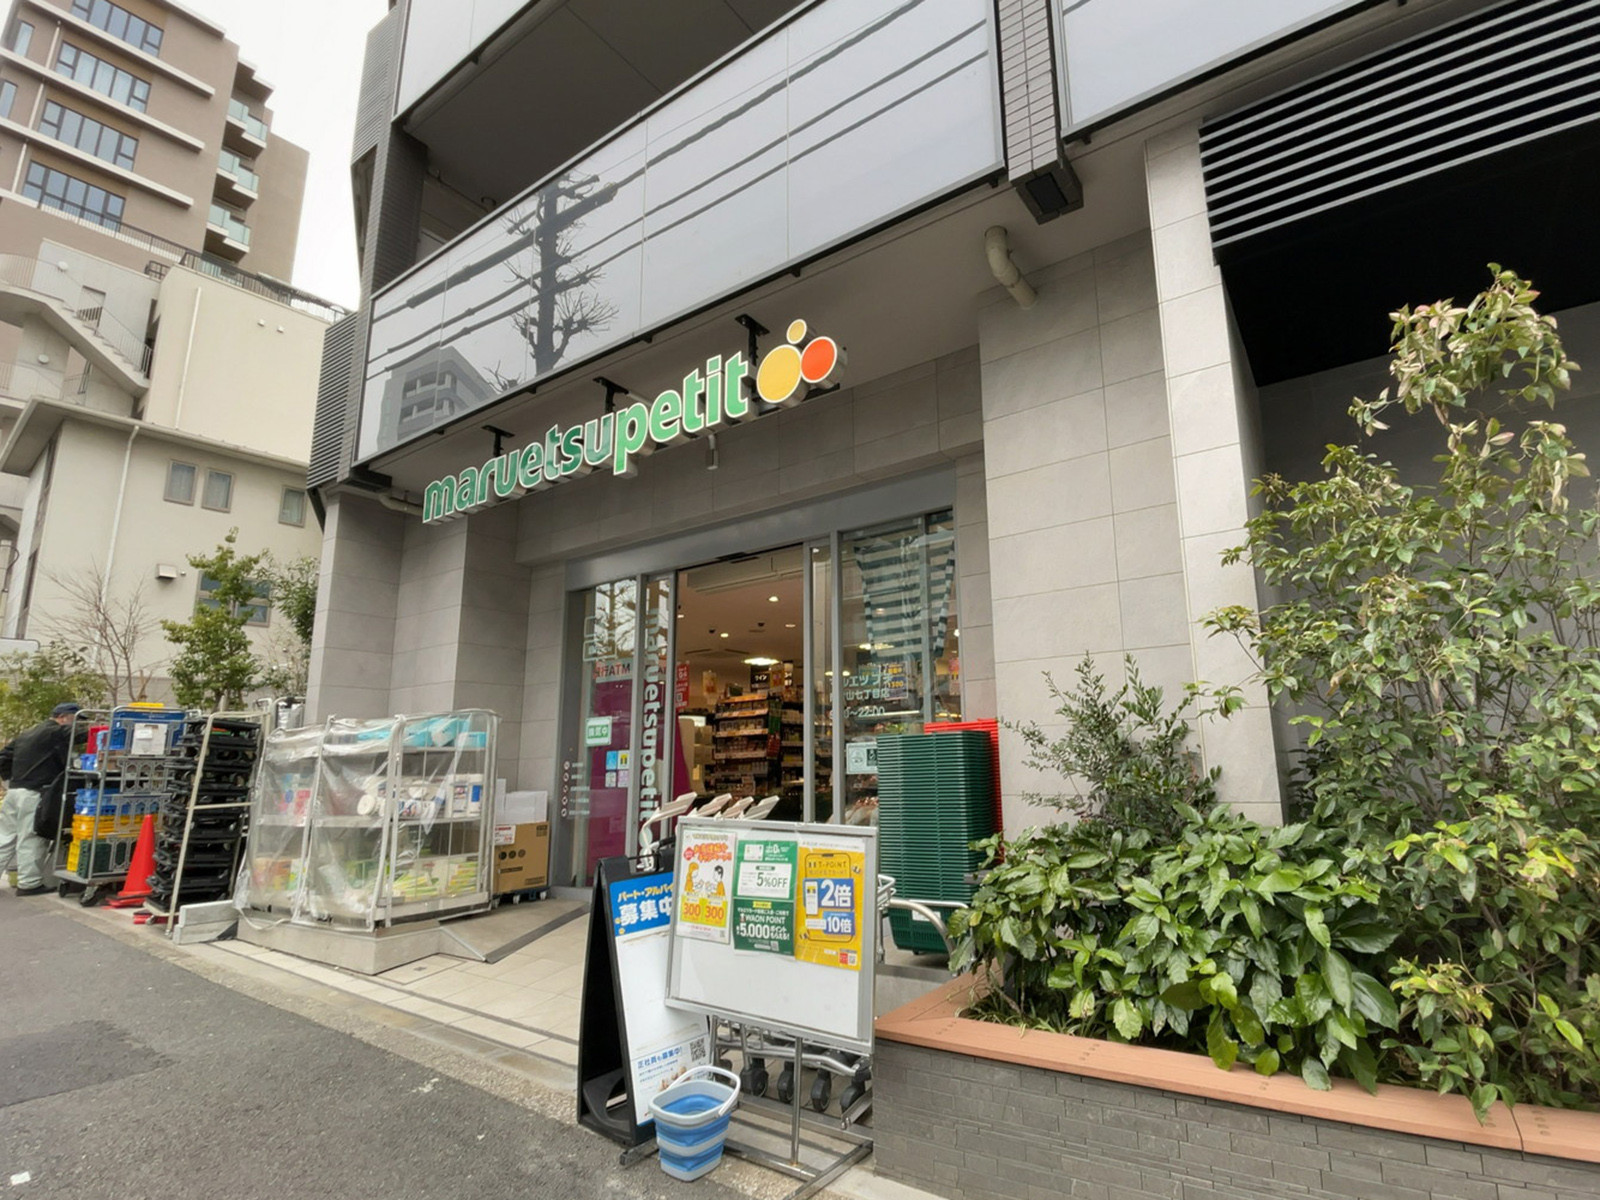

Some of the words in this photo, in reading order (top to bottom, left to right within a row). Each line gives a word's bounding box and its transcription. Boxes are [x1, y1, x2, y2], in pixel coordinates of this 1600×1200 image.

[422, 350, 749, 524] maruetsupetit
[756, 872, 788, 888] 5%OFF
[821, 879, 852, 907] 2倍
[619, 896, 673, 927] 募集中
[683, 902, 701, 917] 300
[705, 905, 725, 920] 300
[766, 915, 786, 925] POINT
[827, 916, 852, 933] 10倍
